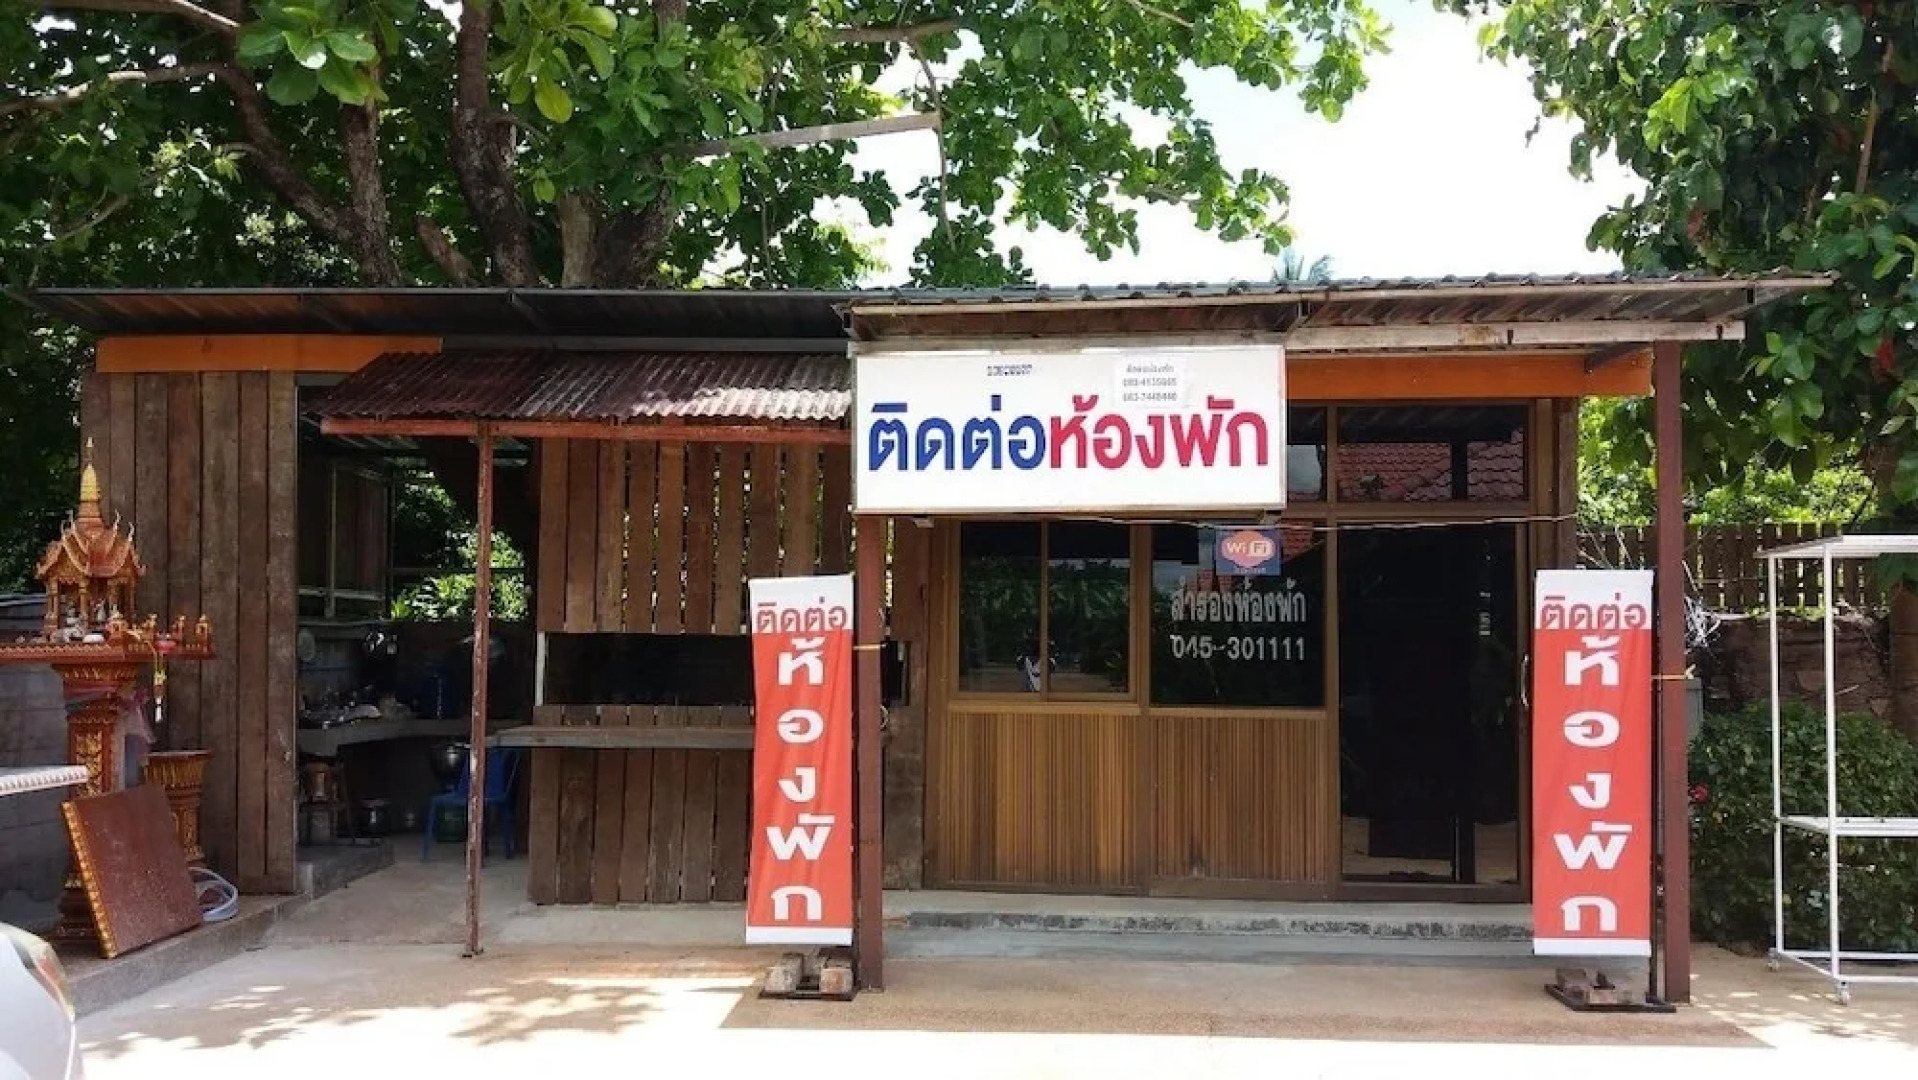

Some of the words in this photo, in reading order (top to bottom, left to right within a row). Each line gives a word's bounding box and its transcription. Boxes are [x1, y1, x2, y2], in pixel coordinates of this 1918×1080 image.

[868, 394, 1269, 471] ติดต่อห้องพัก
[756, 596, 848, 634] ติดต่อ
[1540, 592, 1647, 630] ติดต่อ
